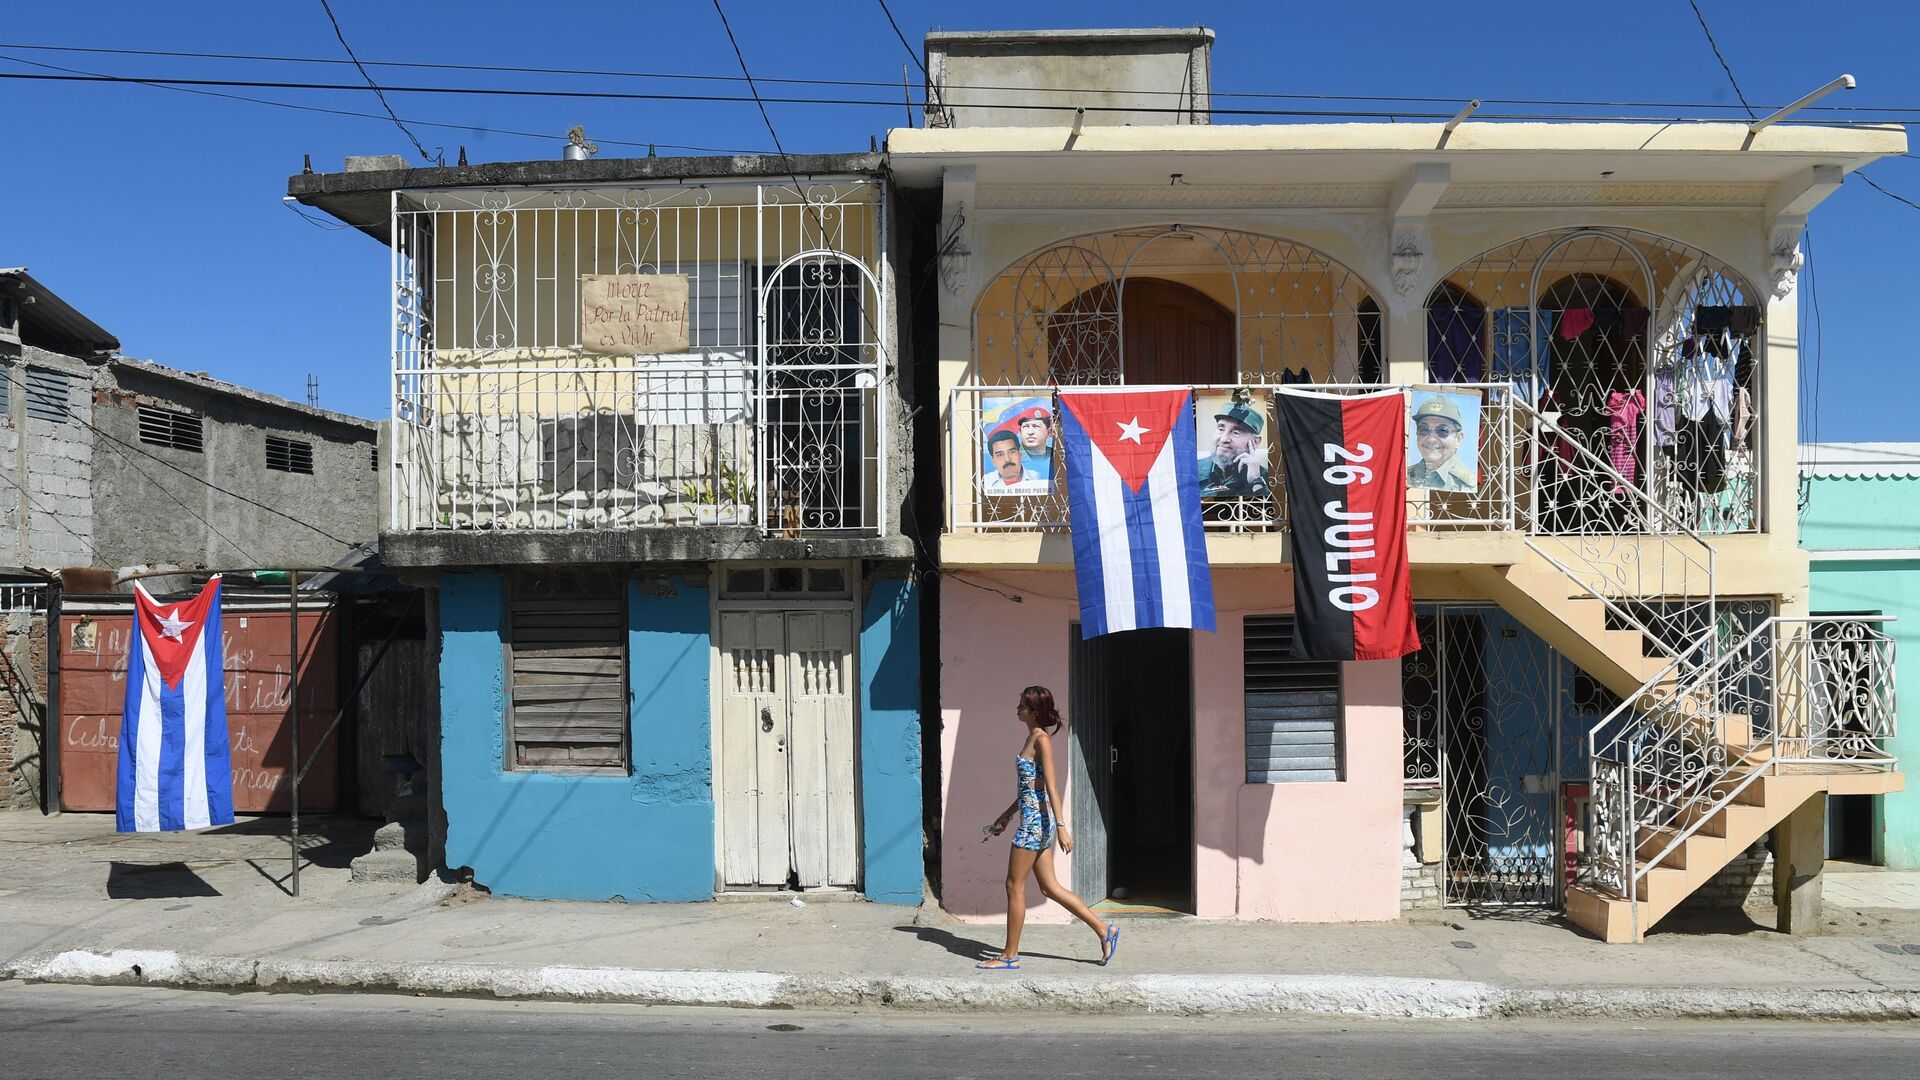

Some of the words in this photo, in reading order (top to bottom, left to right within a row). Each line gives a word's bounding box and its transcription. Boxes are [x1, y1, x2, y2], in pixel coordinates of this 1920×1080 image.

[619, 304, 630, 323] la
[600, 334, 616, 347] es
[1323, 442, 1374, 486] 26
[1323, 500, 1380, 612] JULIO
[68, 715, 118, 749] Cuba
